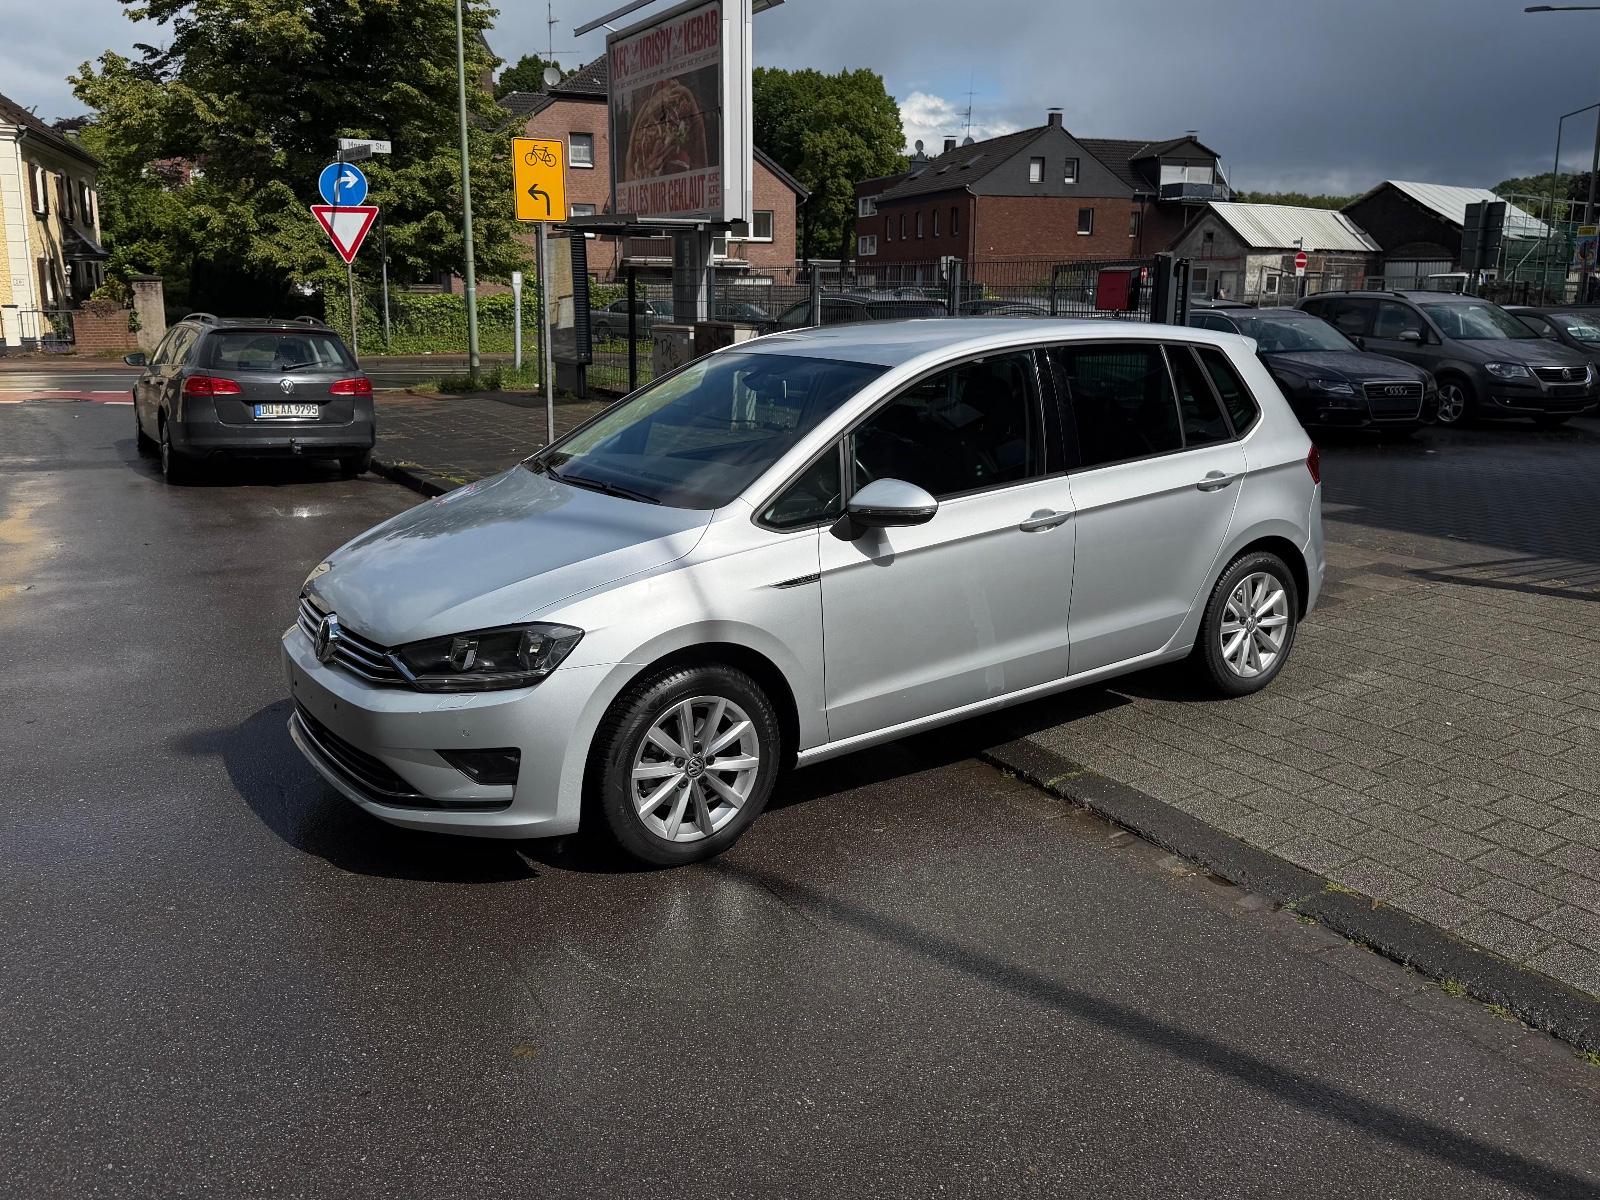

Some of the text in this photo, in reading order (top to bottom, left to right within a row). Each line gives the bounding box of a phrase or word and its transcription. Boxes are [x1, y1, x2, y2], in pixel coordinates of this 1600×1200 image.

[613, 45, 630, 80] KFC
[640, 27, 673, 70] KRISPY
[683, 9, 718, 55] KEBAB
[627, 174, 706, 214] ALLES NUR GEKLAUT
[708, 184, 720, 195] KFC
[708, 196, 720, 208] KFC
[262, 404, 318, 415] DU AA 9795
